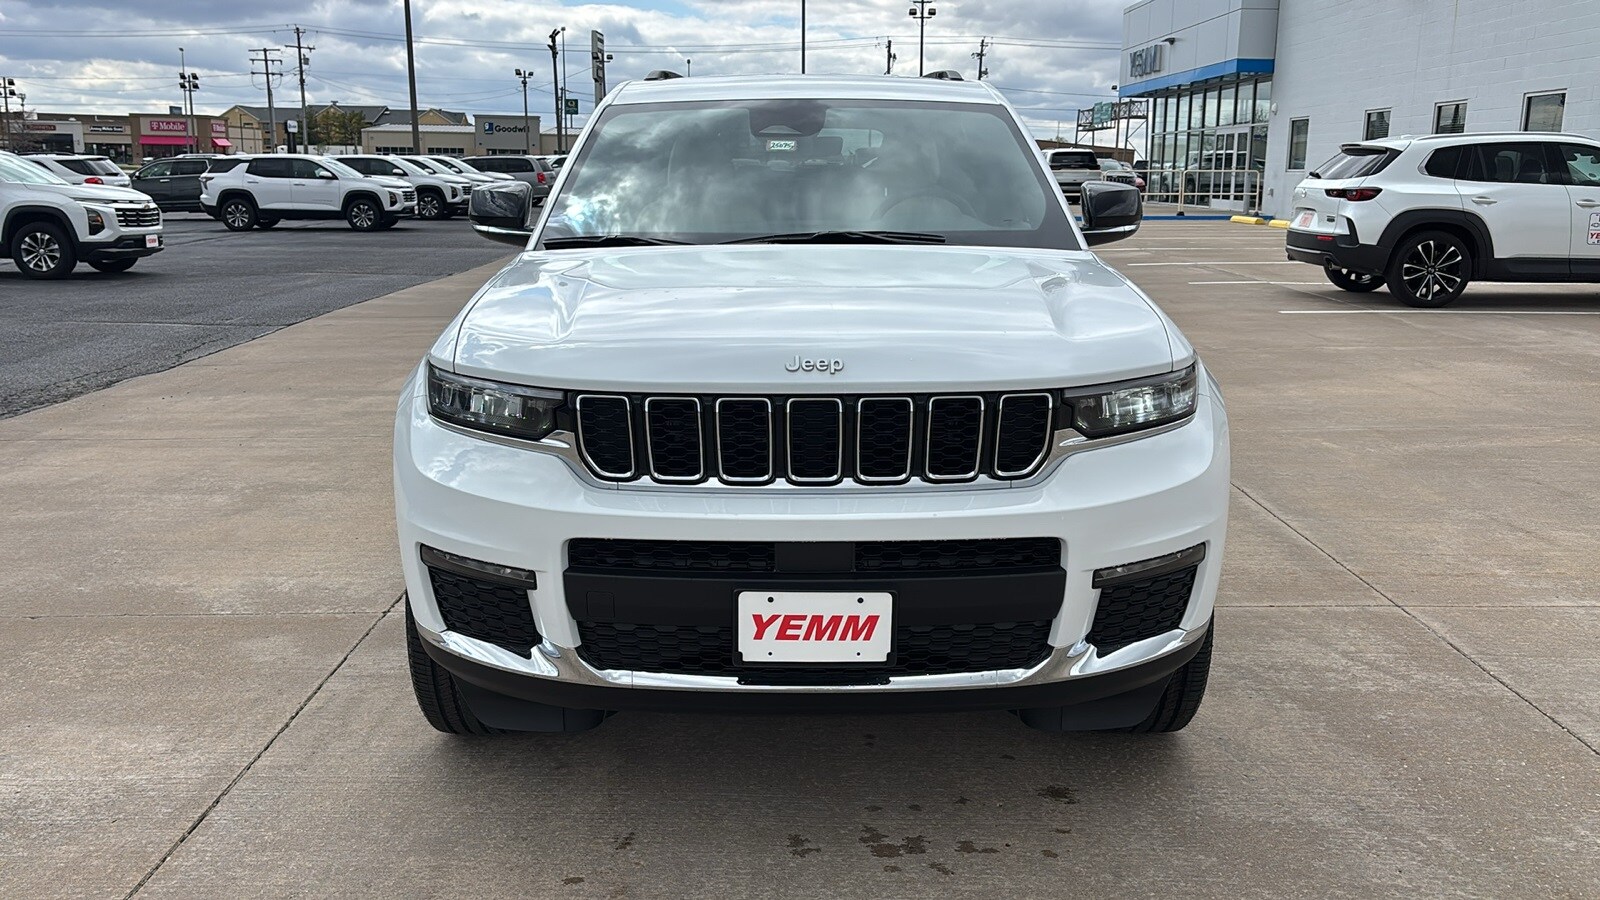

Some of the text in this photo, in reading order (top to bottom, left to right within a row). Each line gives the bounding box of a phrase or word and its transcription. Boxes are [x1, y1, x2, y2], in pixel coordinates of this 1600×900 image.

[494, 125, 530, 133] Goodwil
[784, 355, 845, 375] Jeep
[752, 614, 880, 641] YEMM
